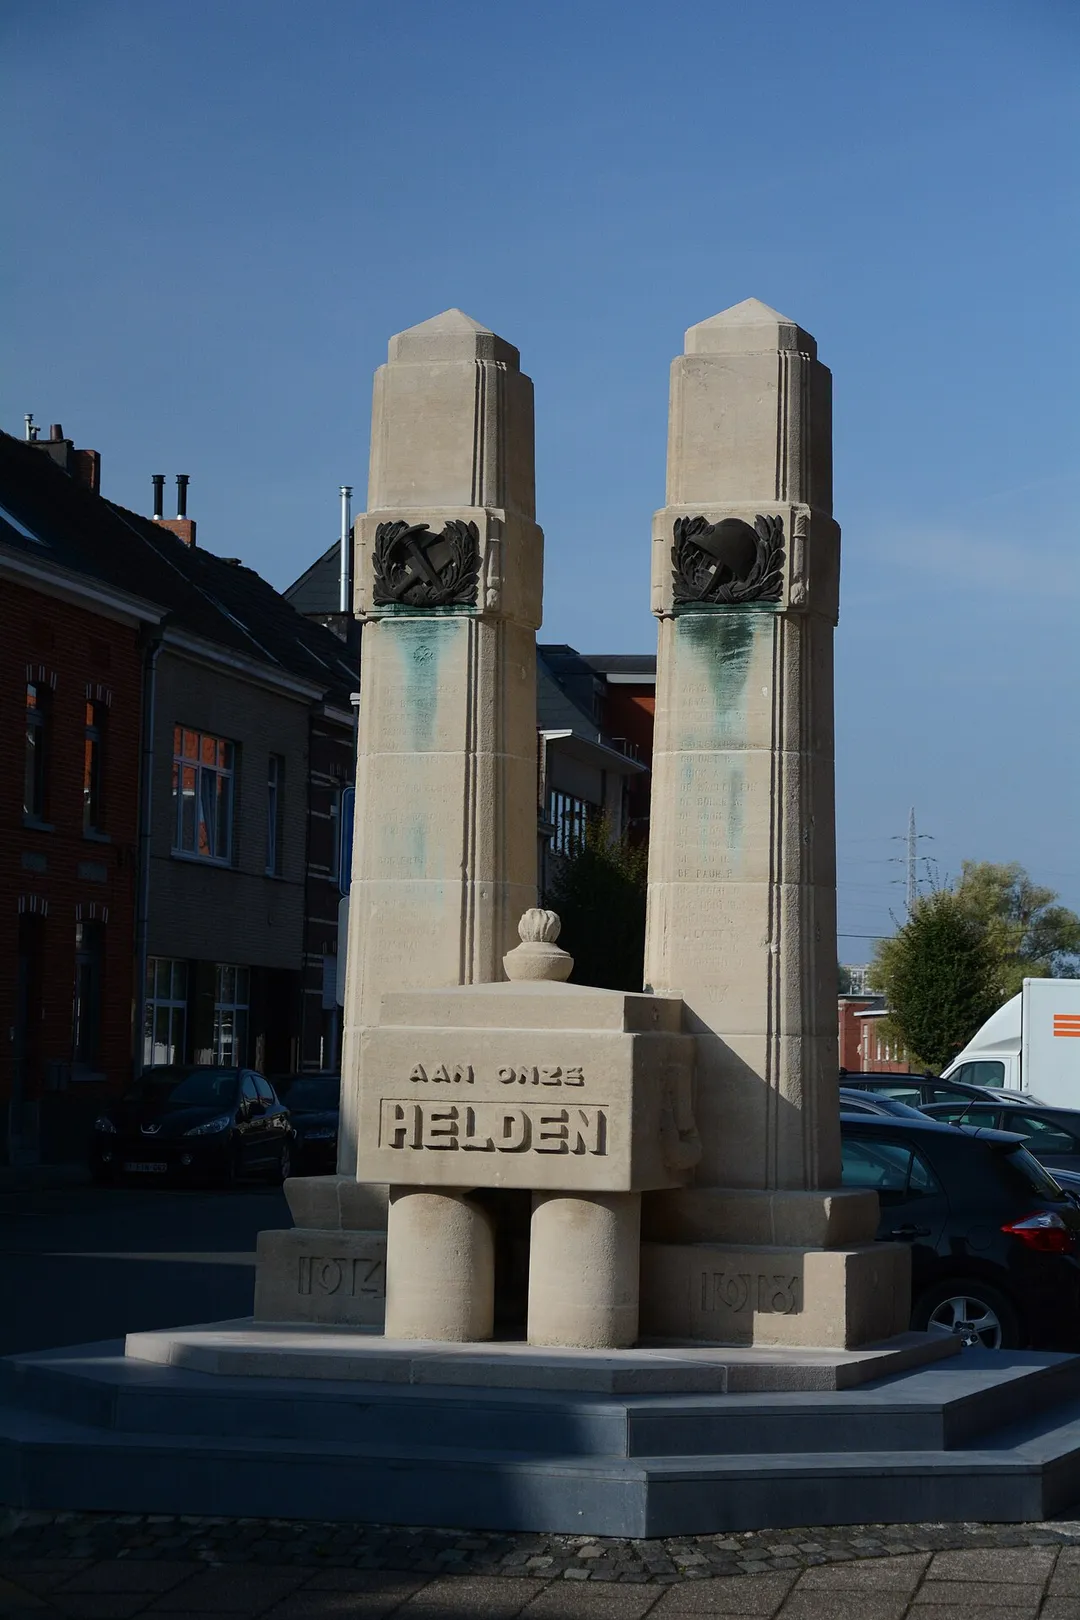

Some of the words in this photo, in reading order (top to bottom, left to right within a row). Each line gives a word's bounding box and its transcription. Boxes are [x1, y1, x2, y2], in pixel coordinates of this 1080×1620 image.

[409, 1064, 474, 1084] AAN
[498, 1065, 585, 1087] ONZE
[386, 1103, 608, 1156] HELDEN
[701, 1272, 799, 1315] 1918
